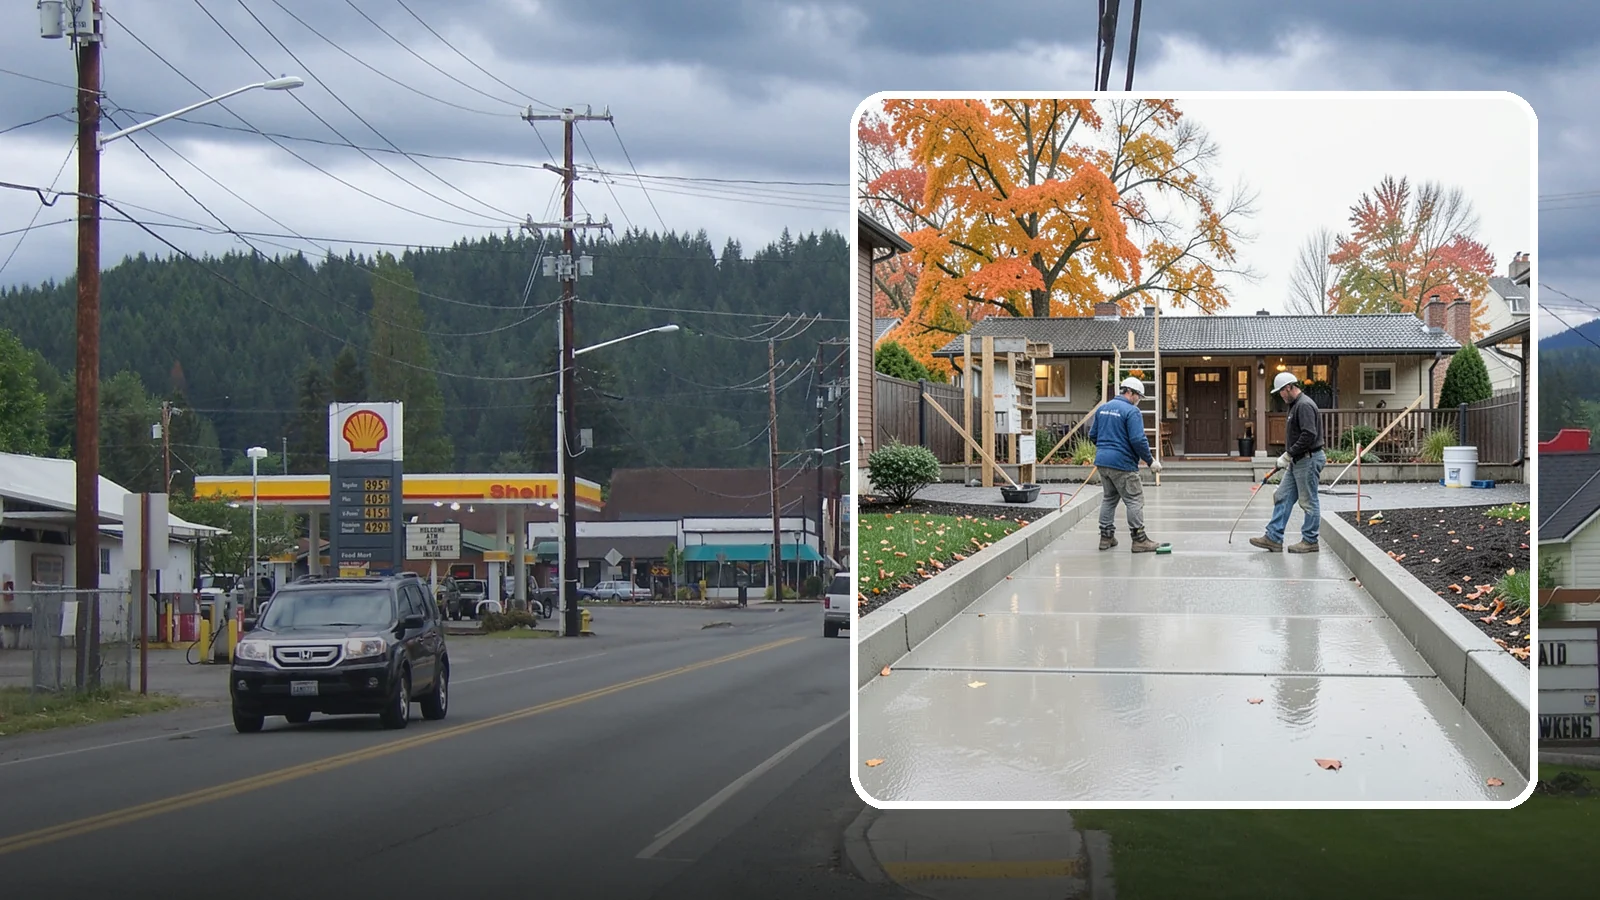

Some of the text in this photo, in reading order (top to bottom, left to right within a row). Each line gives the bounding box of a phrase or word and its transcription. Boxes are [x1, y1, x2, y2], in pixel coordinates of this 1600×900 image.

[490, 484, 547, 498] Shell
[366, 494, 383, 504] 405
[1538, 643, 1566, 665] AID
